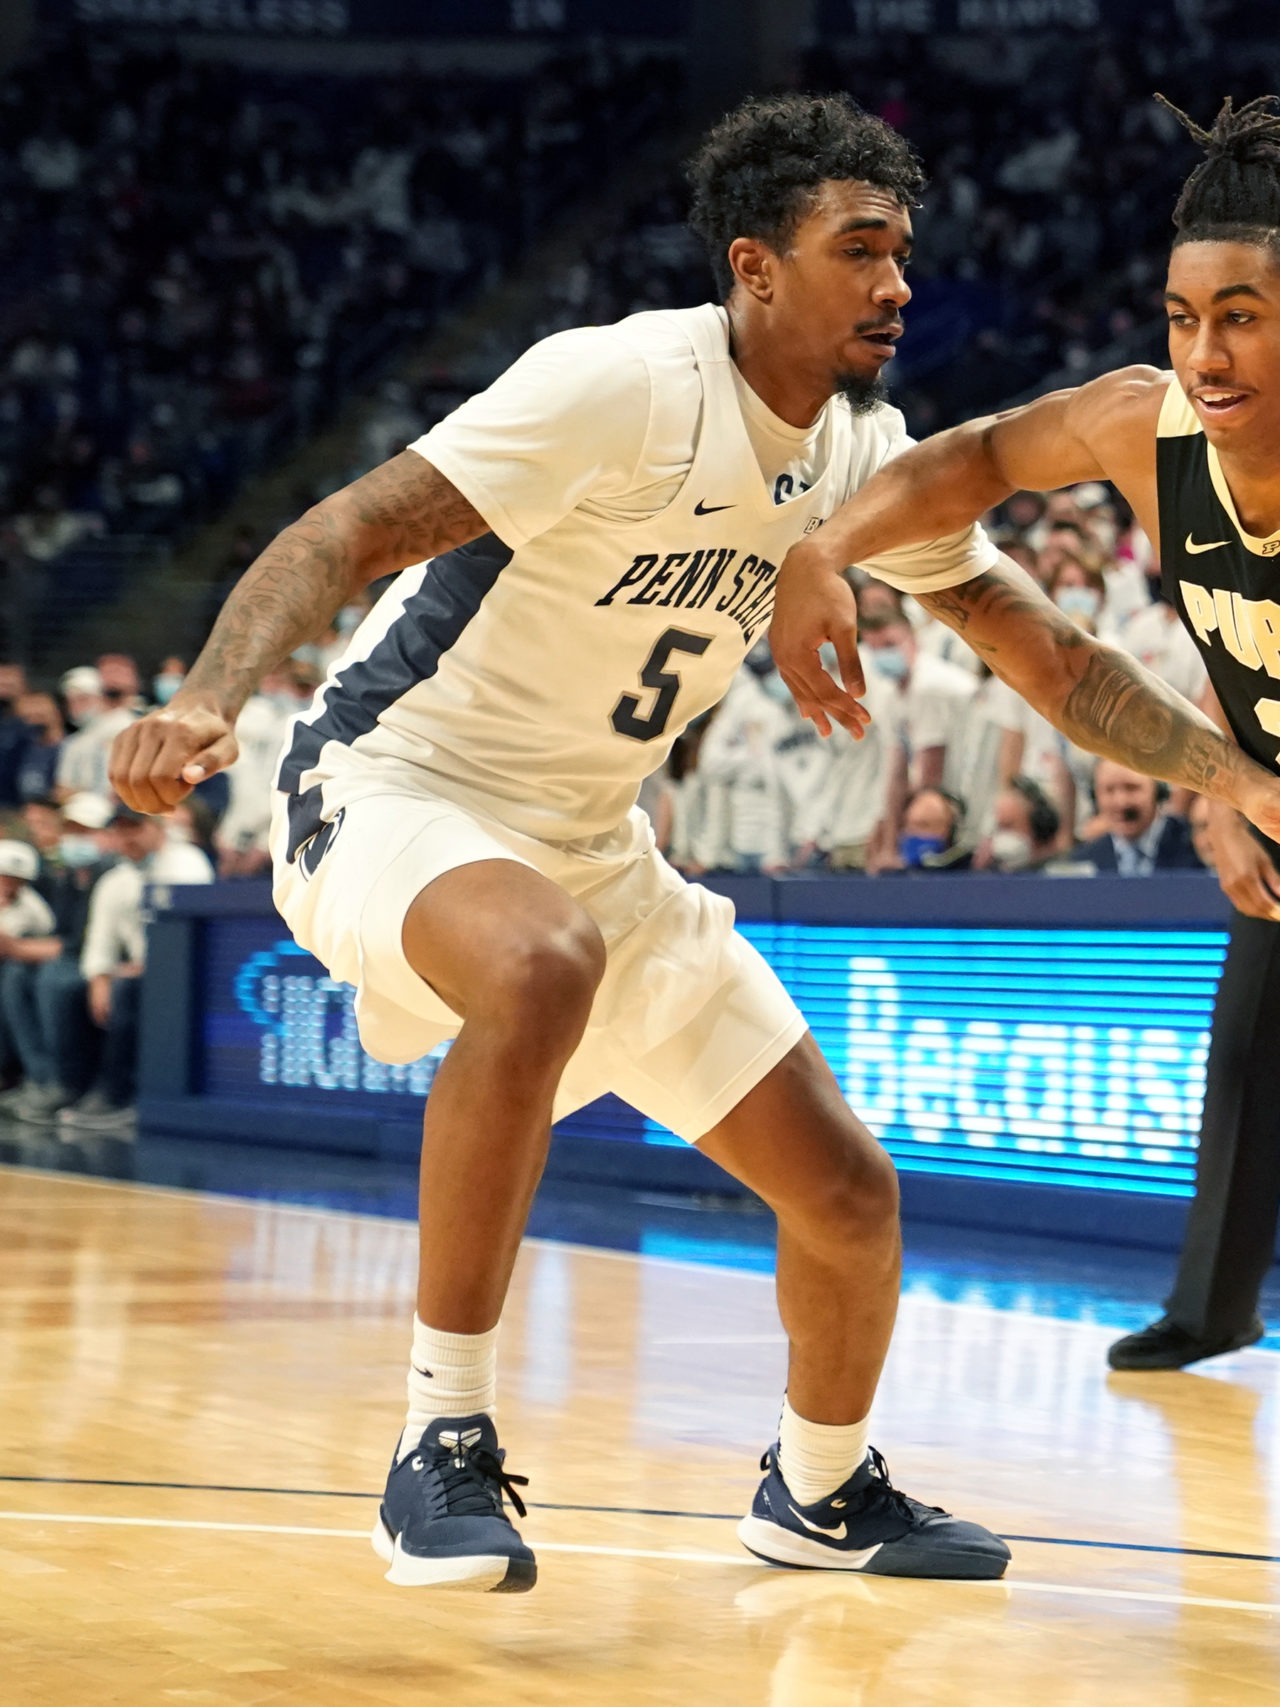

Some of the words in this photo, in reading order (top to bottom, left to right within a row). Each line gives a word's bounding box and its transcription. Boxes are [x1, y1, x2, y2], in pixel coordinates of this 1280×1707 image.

[1262, 540, 1280, 555] P
[594, 548, 737, 608] PENN
[607, 624, 716, 744] 5
